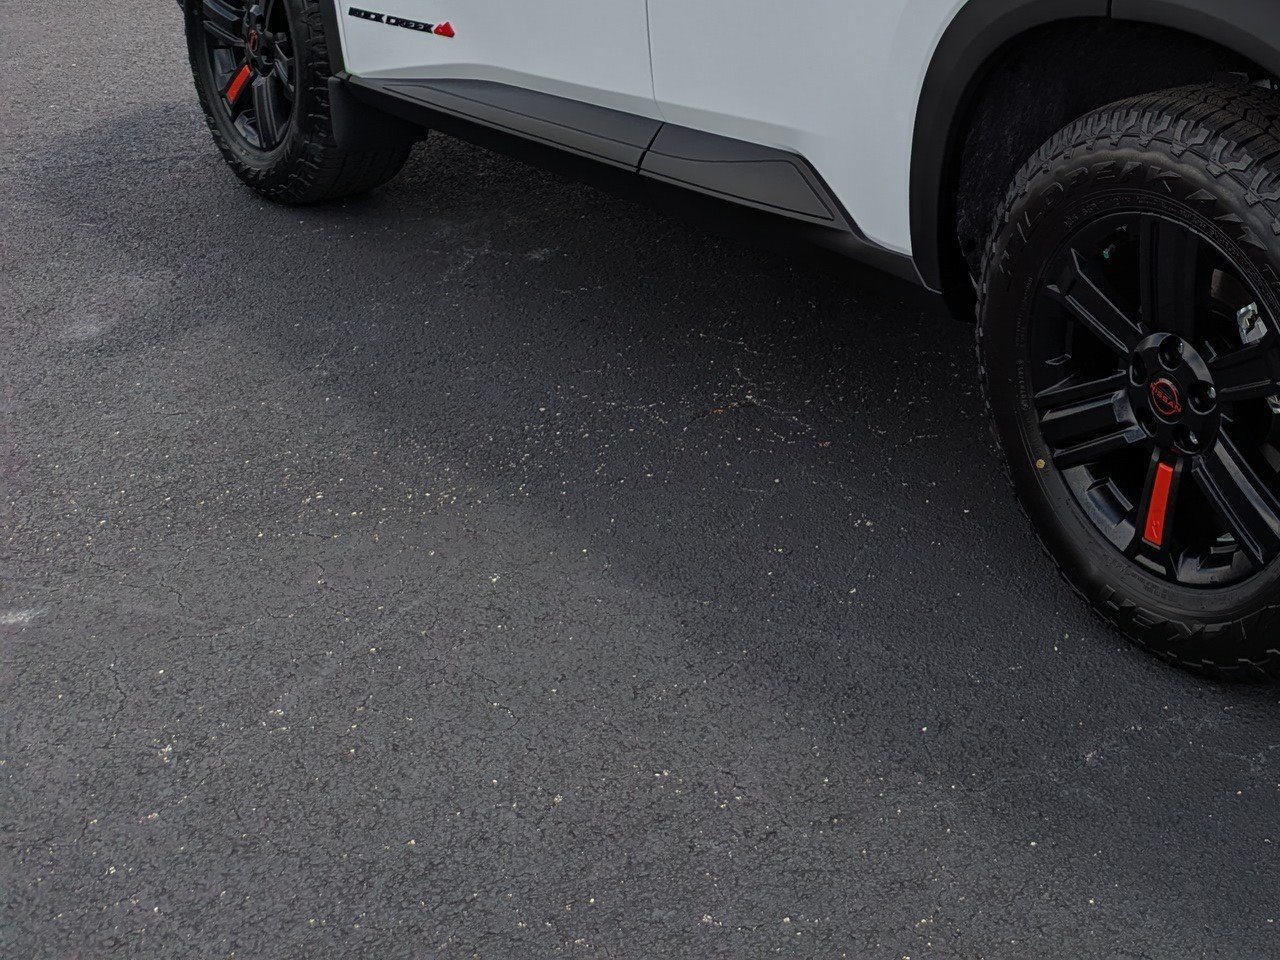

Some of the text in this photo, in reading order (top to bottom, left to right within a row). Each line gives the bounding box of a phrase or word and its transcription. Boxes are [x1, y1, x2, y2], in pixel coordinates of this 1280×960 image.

[348, 6, 434, 34] ROCK CREEK
[1149, 381, 1183, 414] NISSAN
